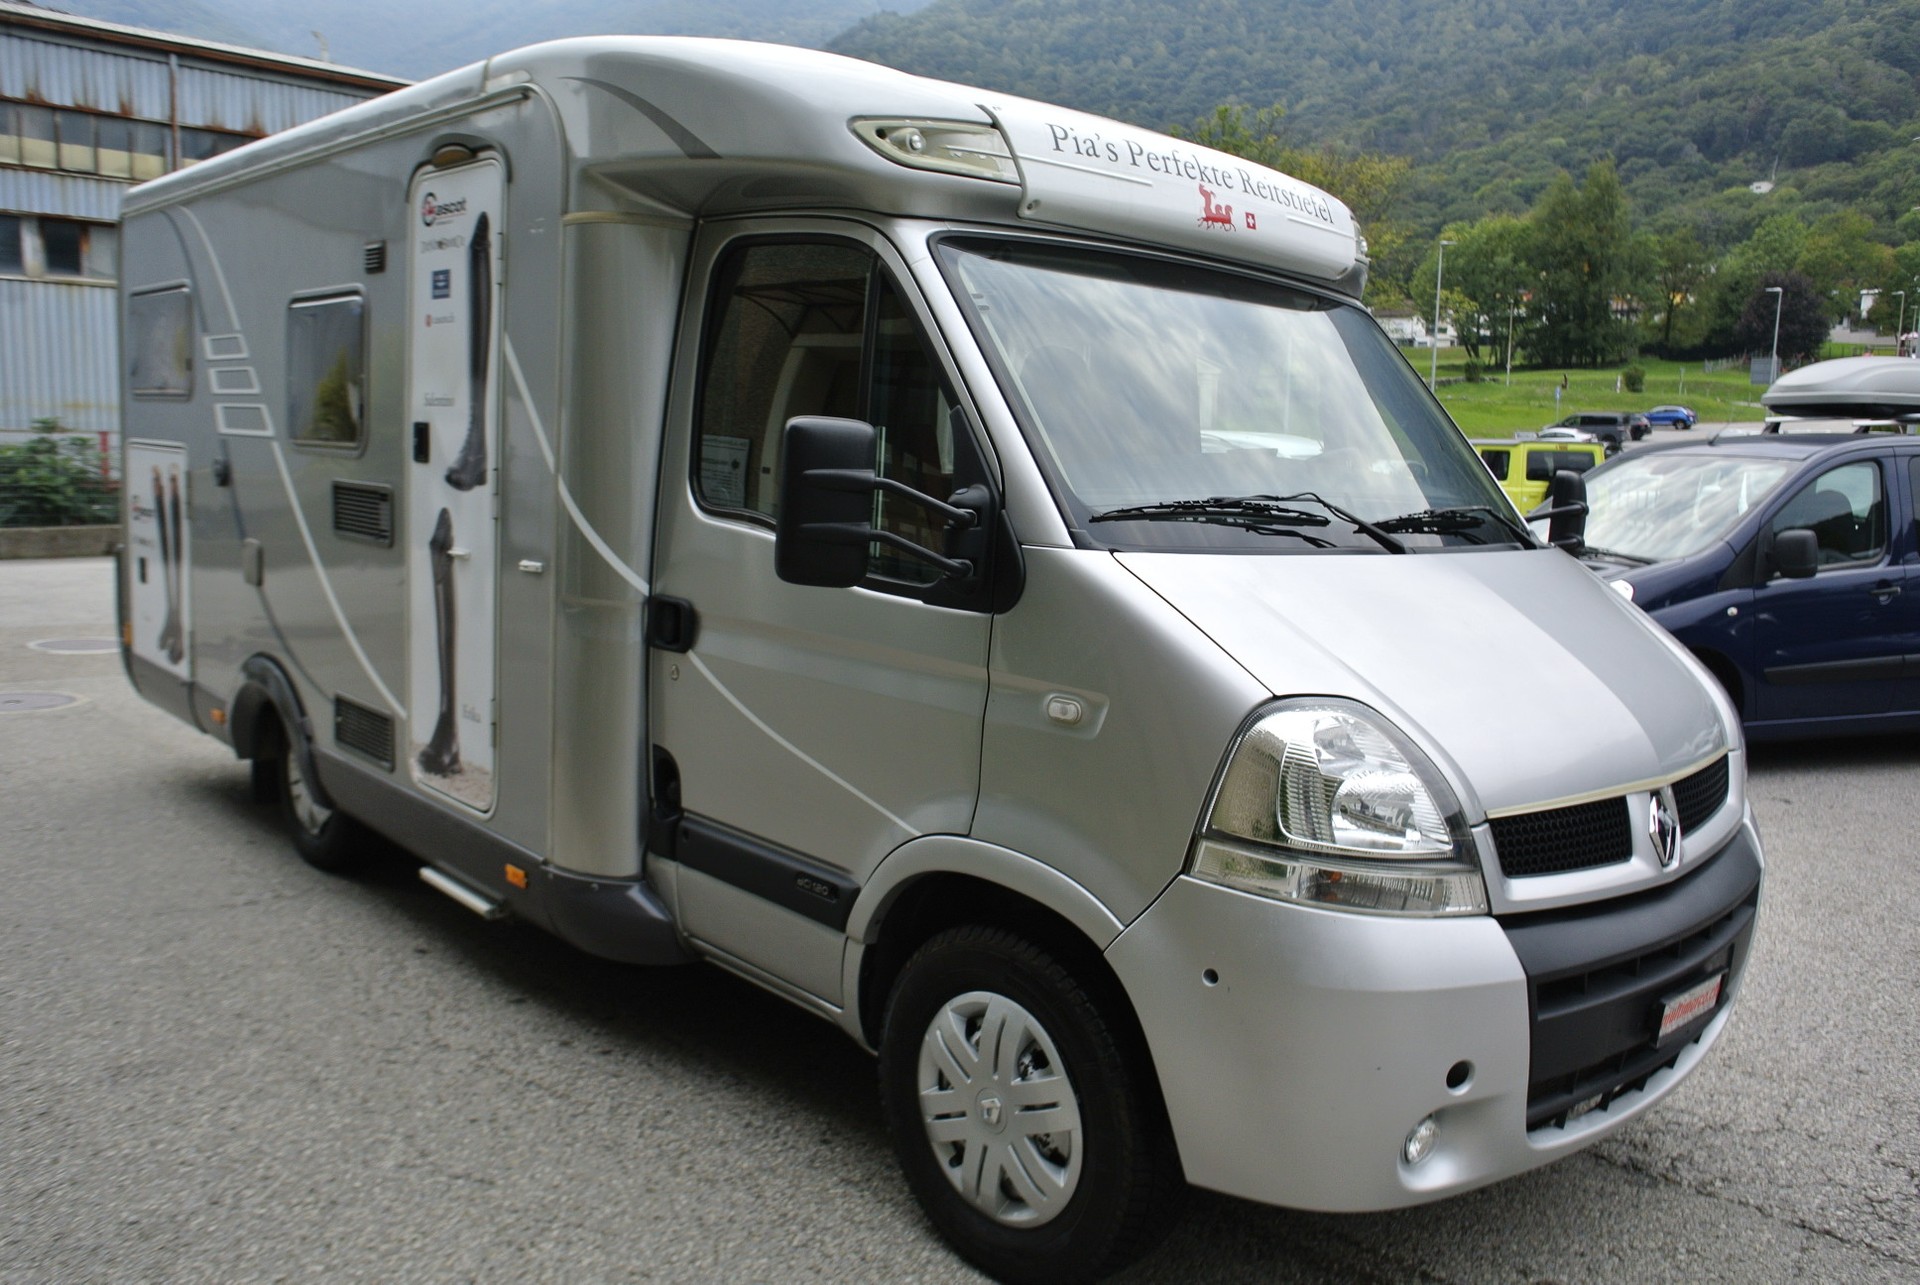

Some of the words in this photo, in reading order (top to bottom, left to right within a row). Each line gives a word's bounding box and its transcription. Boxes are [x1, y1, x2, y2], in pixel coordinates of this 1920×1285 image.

[1046, 122, 1119, 163] Pia's
[1123, 138, 1234, 190] Perfekte
[1235, 167, 1335, 225] Reitstiefel
